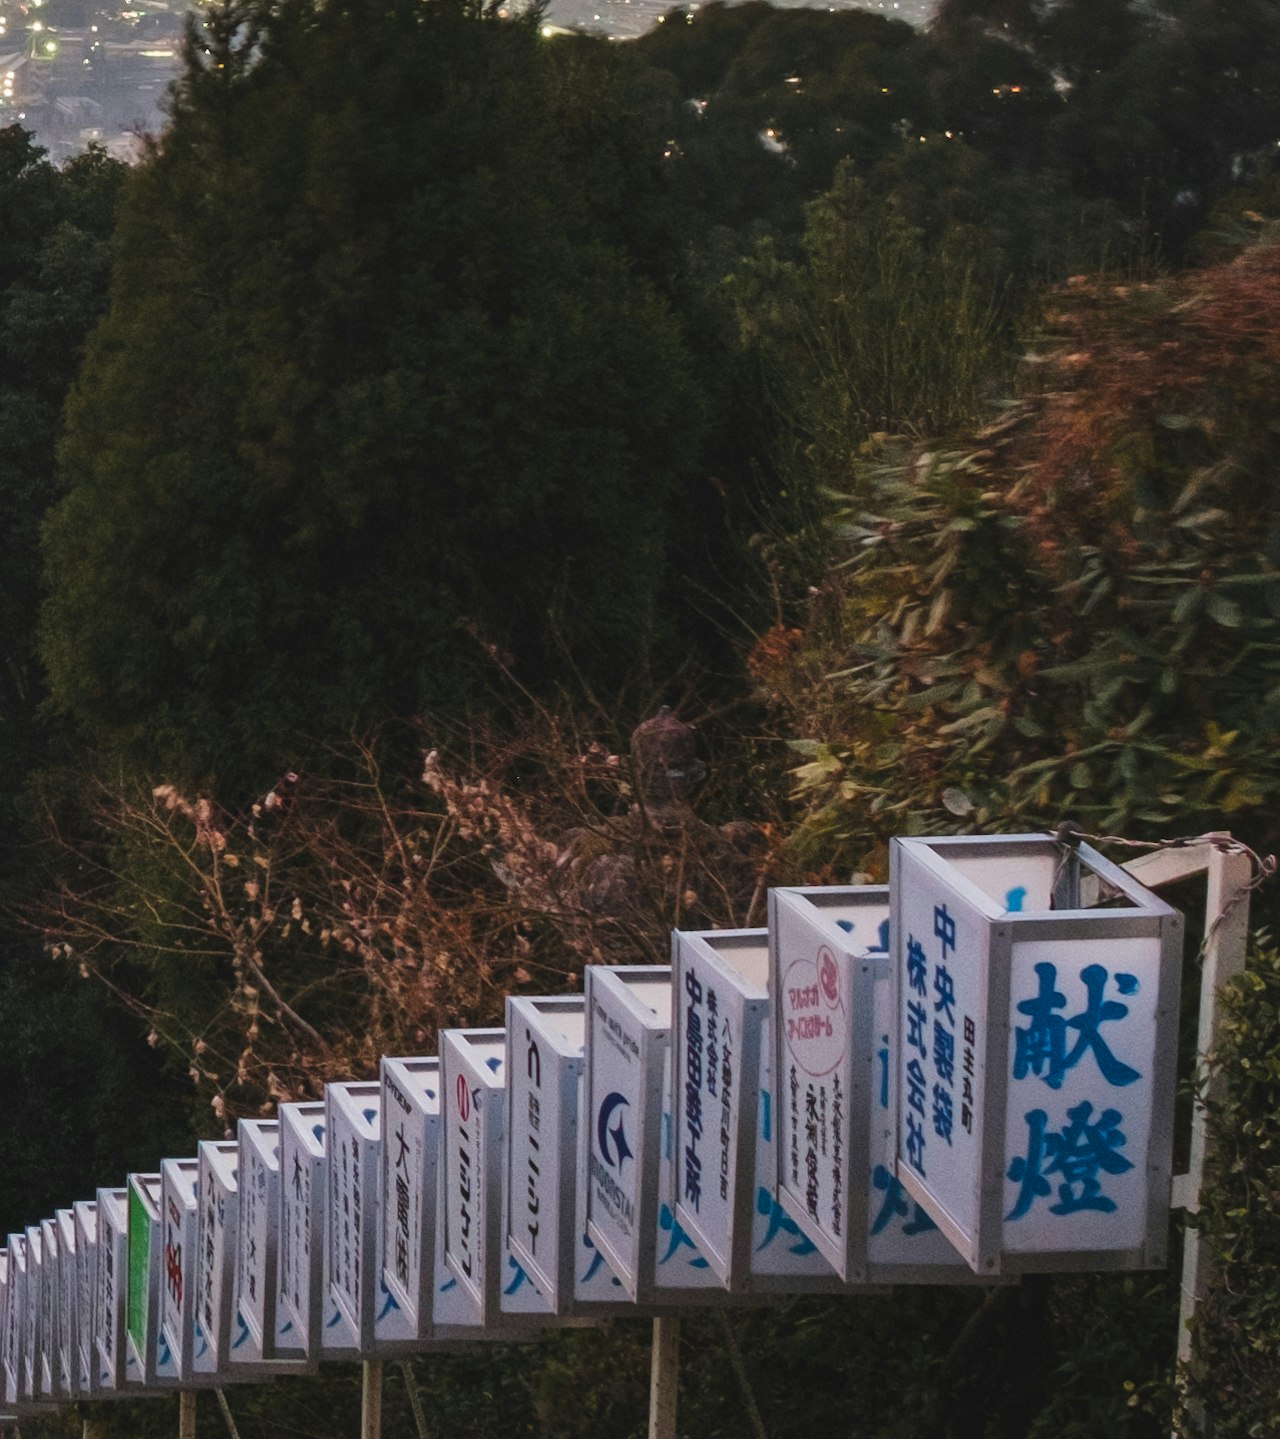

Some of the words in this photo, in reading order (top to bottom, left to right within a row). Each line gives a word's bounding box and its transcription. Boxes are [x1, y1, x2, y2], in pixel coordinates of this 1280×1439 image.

[685, 967, 704, 1213] 中島田鉄工所
[706, 987, 719, 1099] 株式会社
[720, 1017, 733, 1202] 八女郡広川町日吉
[906, 932, 927, 1178] 株式会社
[933, 902, 956, 1147] 中央製袋
[962, 1016, 976, 1134] 田主丸町
[1007, 961, 1142, 1220] 献燈
